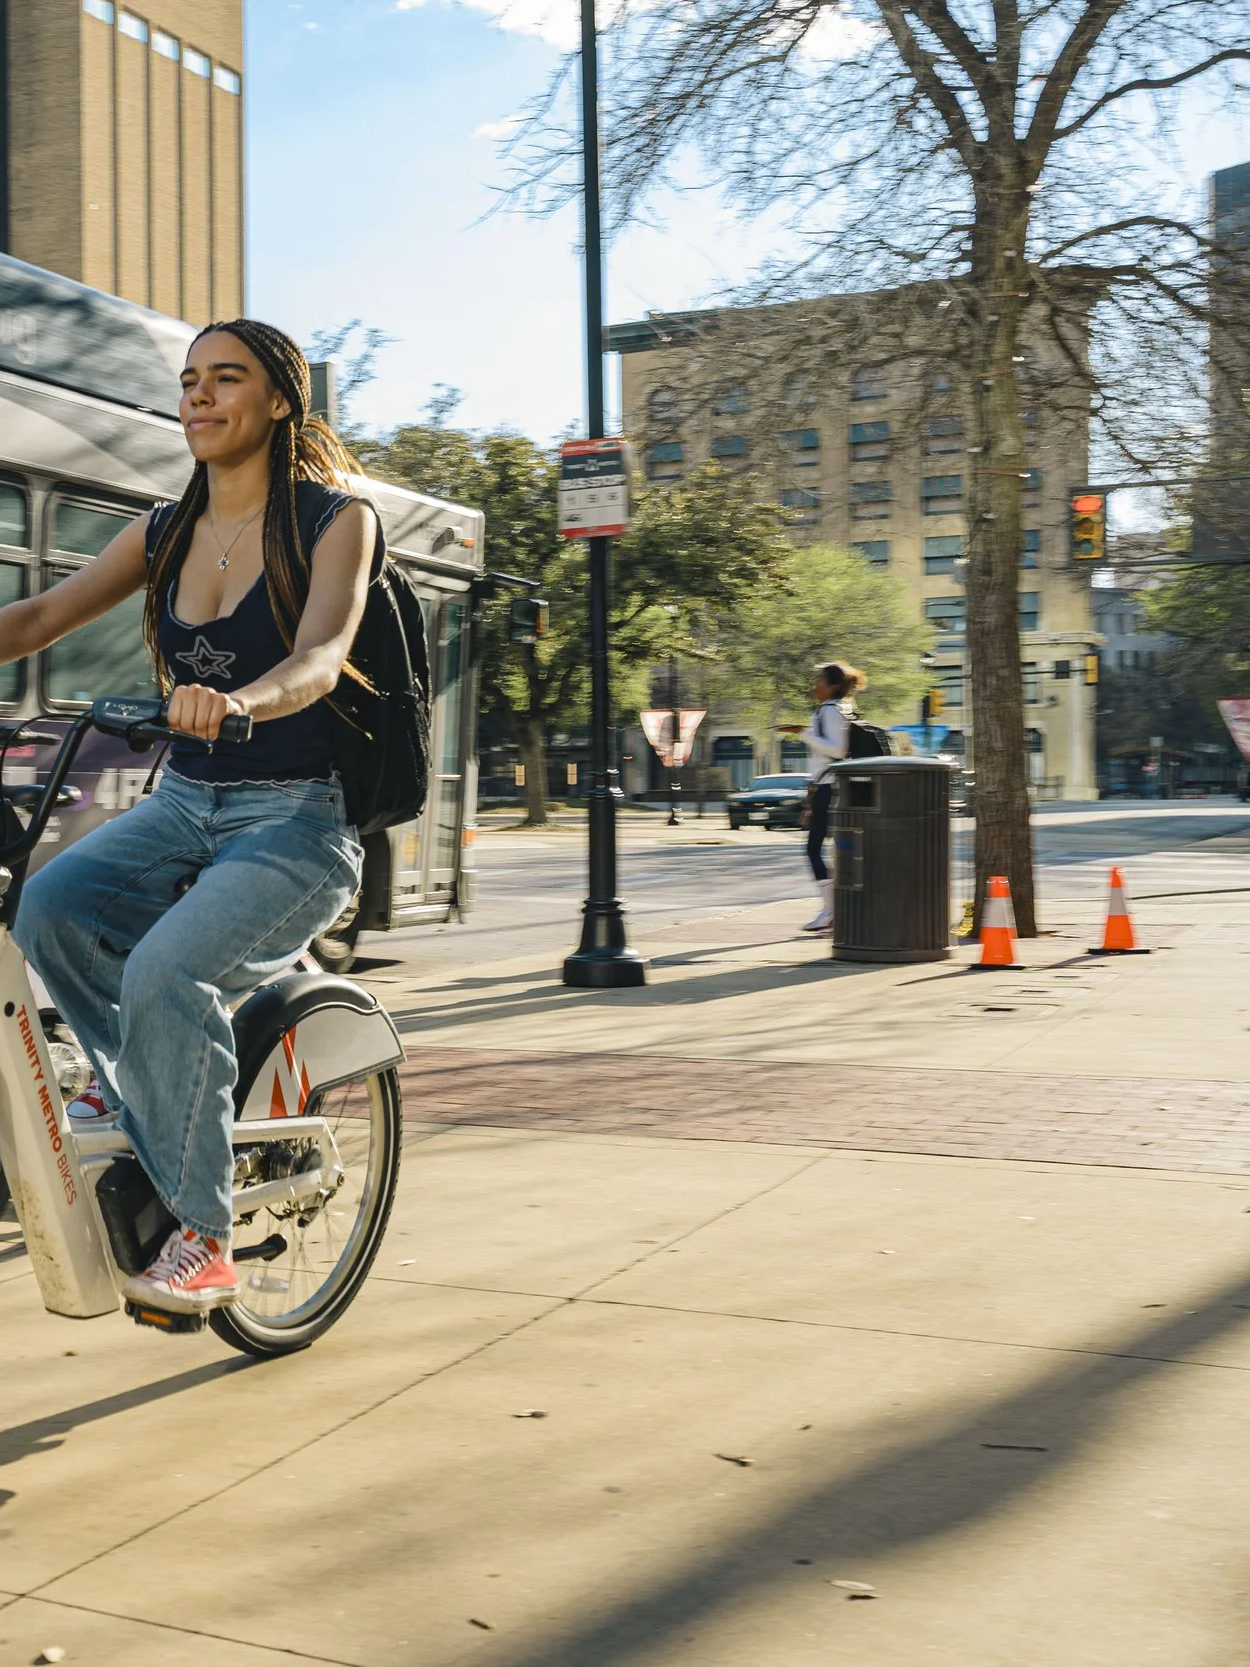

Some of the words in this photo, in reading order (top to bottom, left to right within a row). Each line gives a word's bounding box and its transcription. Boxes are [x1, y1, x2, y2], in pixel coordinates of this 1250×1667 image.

[16, 1004, 44, 1081] TRINITY
[38, 1084, 62, 1153] METRO
[57, 1154, 77, 1205] BIKES
